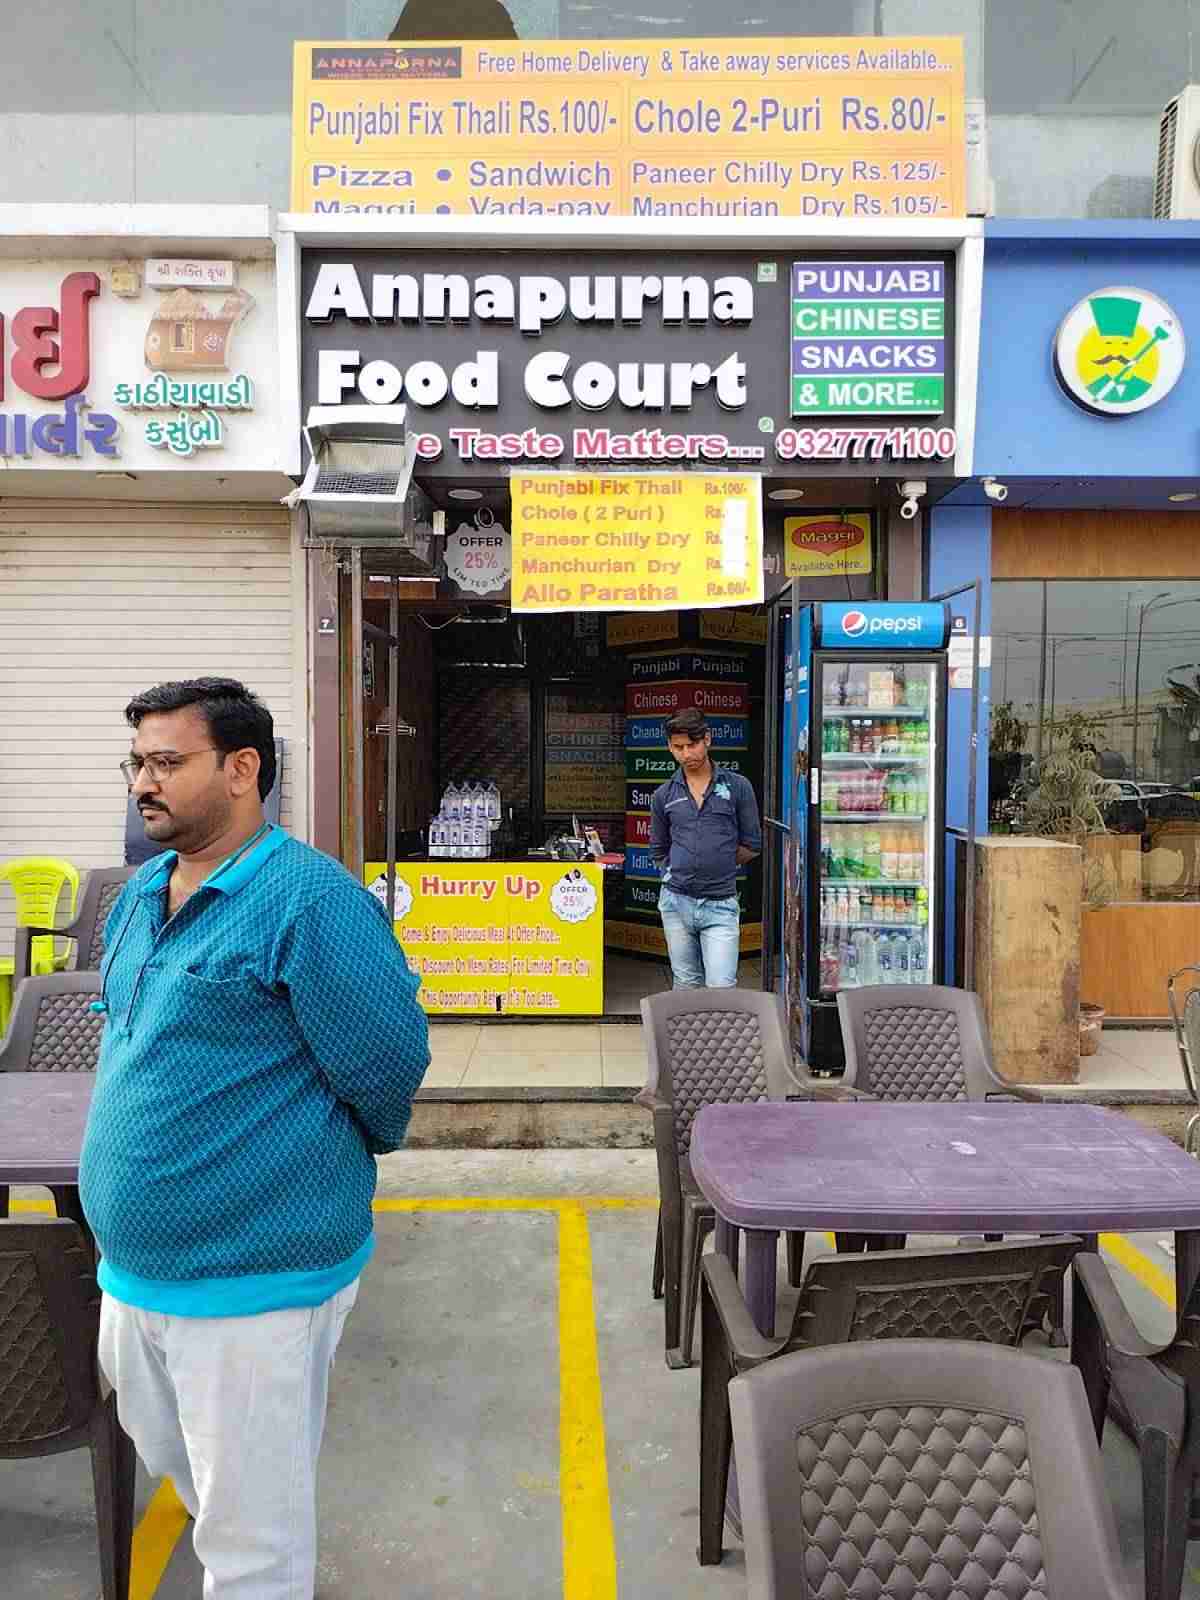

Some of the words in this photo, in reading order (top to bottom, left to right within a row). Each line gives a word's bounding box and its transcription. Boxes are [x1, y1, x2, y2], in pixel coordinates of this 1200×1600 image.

[478, 51, 516, 73] Free
[521, 51, 572, 72] Home
[578, 50, 649, 77] Delivery
[660, 50, 673, 72] &
[680, 49, 720, 72] Take
[725, 55, 770, 76] away
[776, 50, 850, 71] services
[856, 48, 953, 71] Available...
[309, 102, 399, 144] Punjabi
[408, 101, 444, 135] Fix
[451, 101, 511, 135] Thali
[519, 100, 617, 135] Rs.100/-
[634, 99, 721, 133] Chole
[731, 97, 821, 132] 2-Puri
[842, 97, 946, 131] Rs.80/-
[312, 164, 413, 187] Pizza
[469, 160, 610, 187] Sandwich
[632, 162, 717, 184] Paneer
[724, 161, 793, 189] Chilly
[800, 162, 844, 187] Dry
[852, 160, 947, 181] Rs.125/-
[632, 196, 779, 217] Manchurian
[802, 196, 846, 216] Dry
[853, 193, 949, 216] Rs.105/-
[797, 269, 941, 293] PUNJABI
[304, 262, 755, 336] Annapurna
[795, 307, 943, 331] CHINESE
[800, 345, 937, 369] SNACKS
[317, 349, 499, 408] Food
[523, 350, 748, 411] Court
[799, 382, 819, 406] &
[828, 382, 940, 407] MORE...
[450, 427, 564, 459] Taste
[571, 428, 766, 459] Matters...
[776, 428, 957, 460] 9327771100
[520, 479, 594, 498] Punjabi
[600, 479, 630, 495] Fix
[634, 479, 683, 495] Thali
[521, 504, 577, 521] Chole
[595, 505, 608, 521] 2
[613, 505, 652, 521] Puri
[459, 536, 503, 547] OFFER
[521, 531, 590, 547] Paneer
[594, 531, 650, 550] Chilly
[656, 531, 691, 549] Dry
[464, 551, 498, 569] 25%
[521, 558, 636, 574] Manchurian
[647, 559, 682, 575] Dry
[521, 583, 573, 602] Allo
[580, 583, 679, 601] Paratha
[320, 618, 331, 629] 7
[869, 614, 922, 637] pepsi
[632, 657, 681, 677] Punjabi
[692, 656, 745, 676] Punjabi
[633, 690, 679, 708] Chinese
[694, 688, 742, 707] Chinese
[634, 757, 676, 771] Pizza
[421, 876, 496, 900] Hurry
[505, 876, 541, 900] Up
